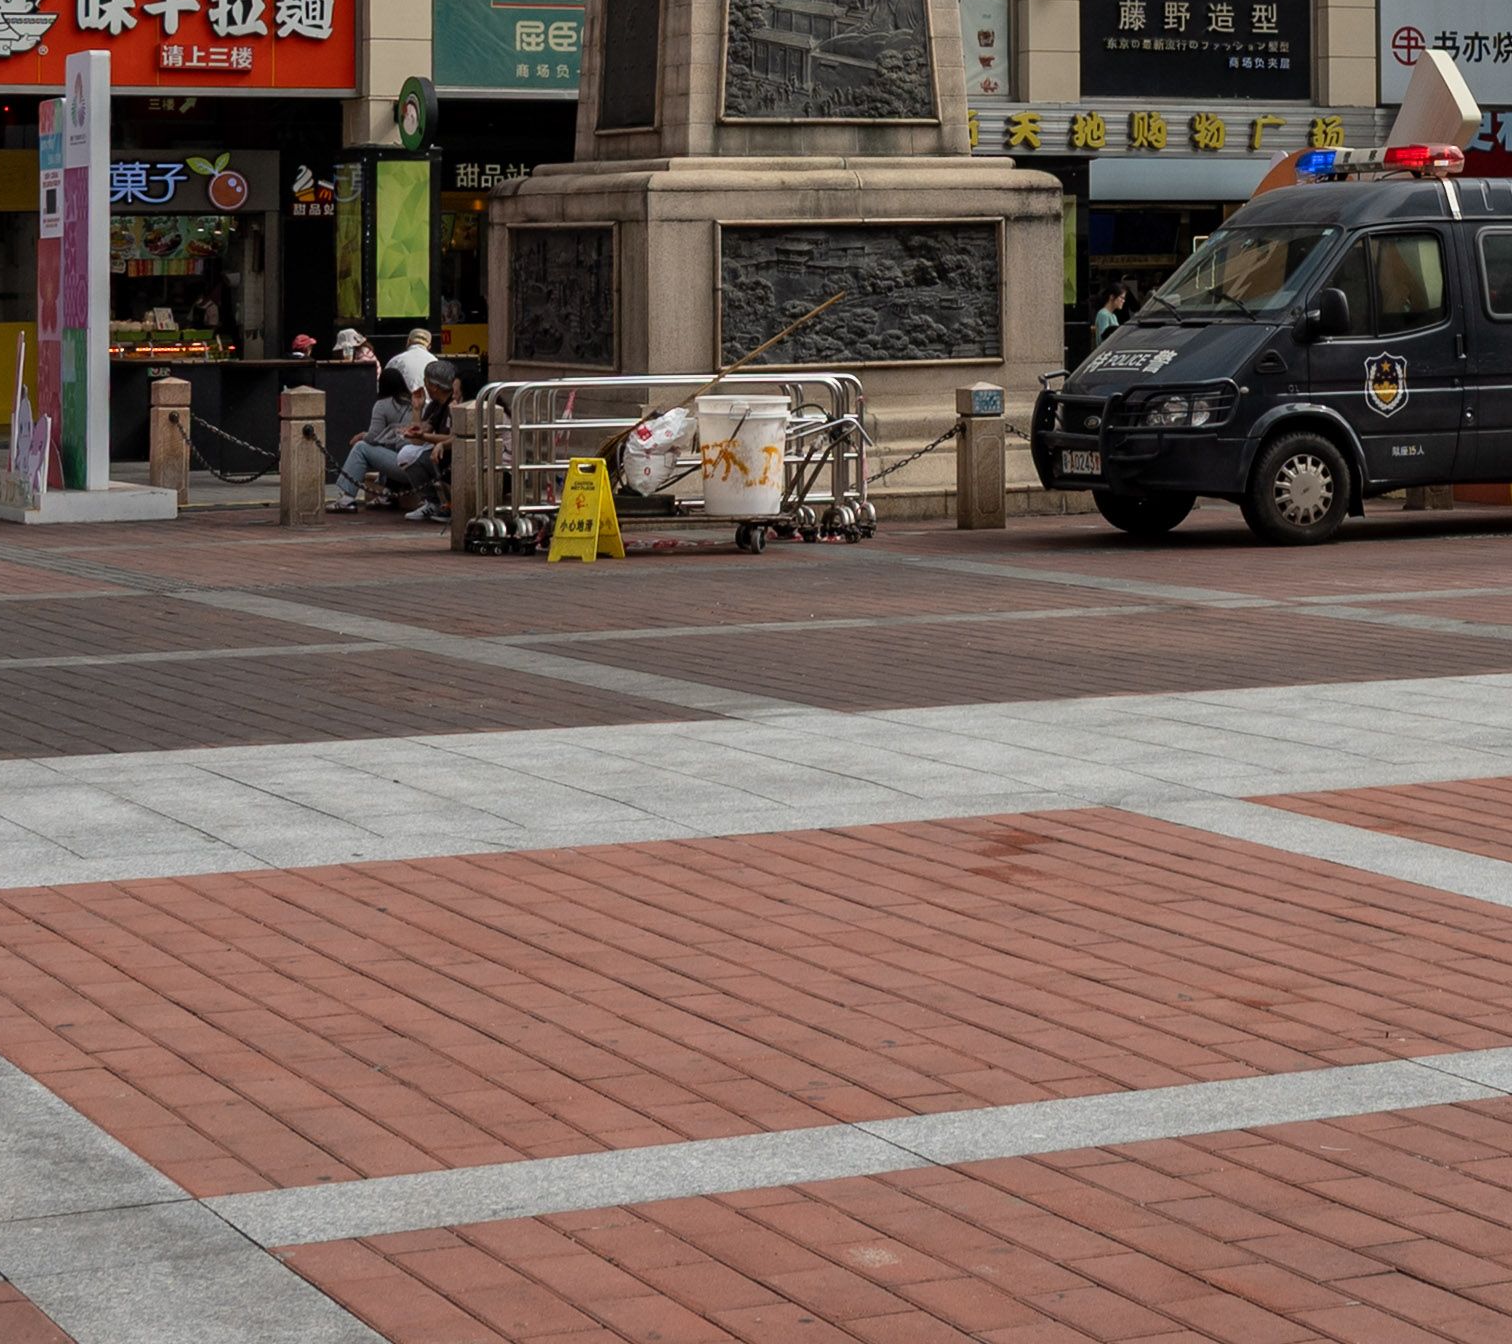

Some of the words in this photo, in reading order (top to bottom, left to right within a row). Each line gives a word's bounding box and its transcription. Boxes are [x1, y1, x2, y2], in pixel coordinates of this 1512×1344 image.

[1118, 0, 1279, 34] 藤野造型
[514, 20, 585, 54] 屈臣
[161, 45, 254, 70] 请上三楼
[1104, 353, 1153, 369] POLICE
[559, 518, 593, 534] 小心地滑
